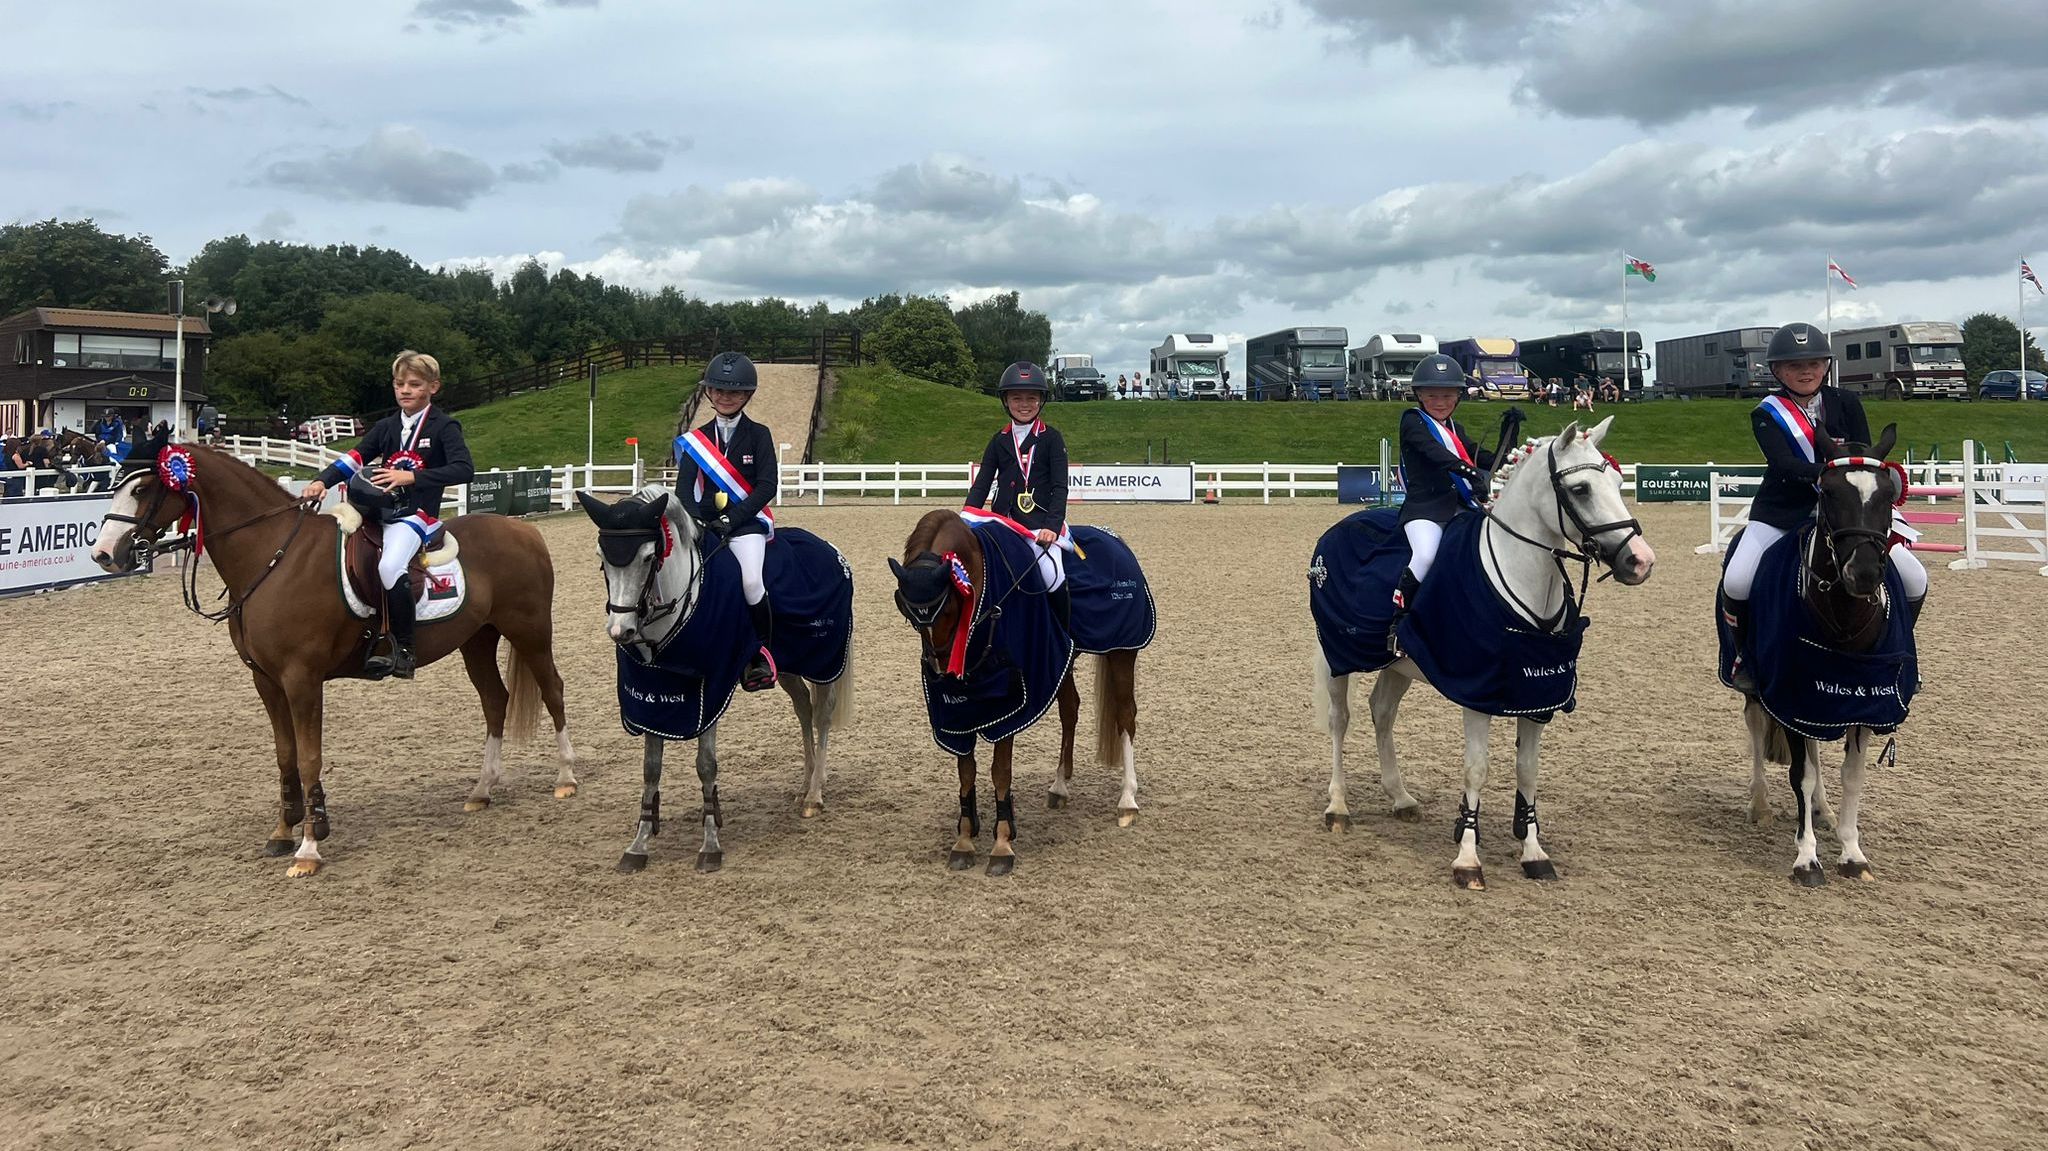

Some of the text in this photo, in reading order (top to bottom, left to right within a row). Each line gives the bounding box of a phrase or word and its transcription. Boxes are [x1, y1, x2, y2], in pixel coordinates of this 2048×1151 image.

[1068, 475, 1161, 487] INE AMERICA
[1641, 480, 1708, 489] EQUESTRIAN
[18, 521, 97, 554] AMERIC
[0, 553, 75, 571] uine-america.co.uk
[1523, 667, 1555, 677] Wales
[1557, 664, 1566, 674] &
[1815, 681, 1895, 697] Wales & West
[645, 692, 655, 703] &
[660, 694, 684, 703] West
